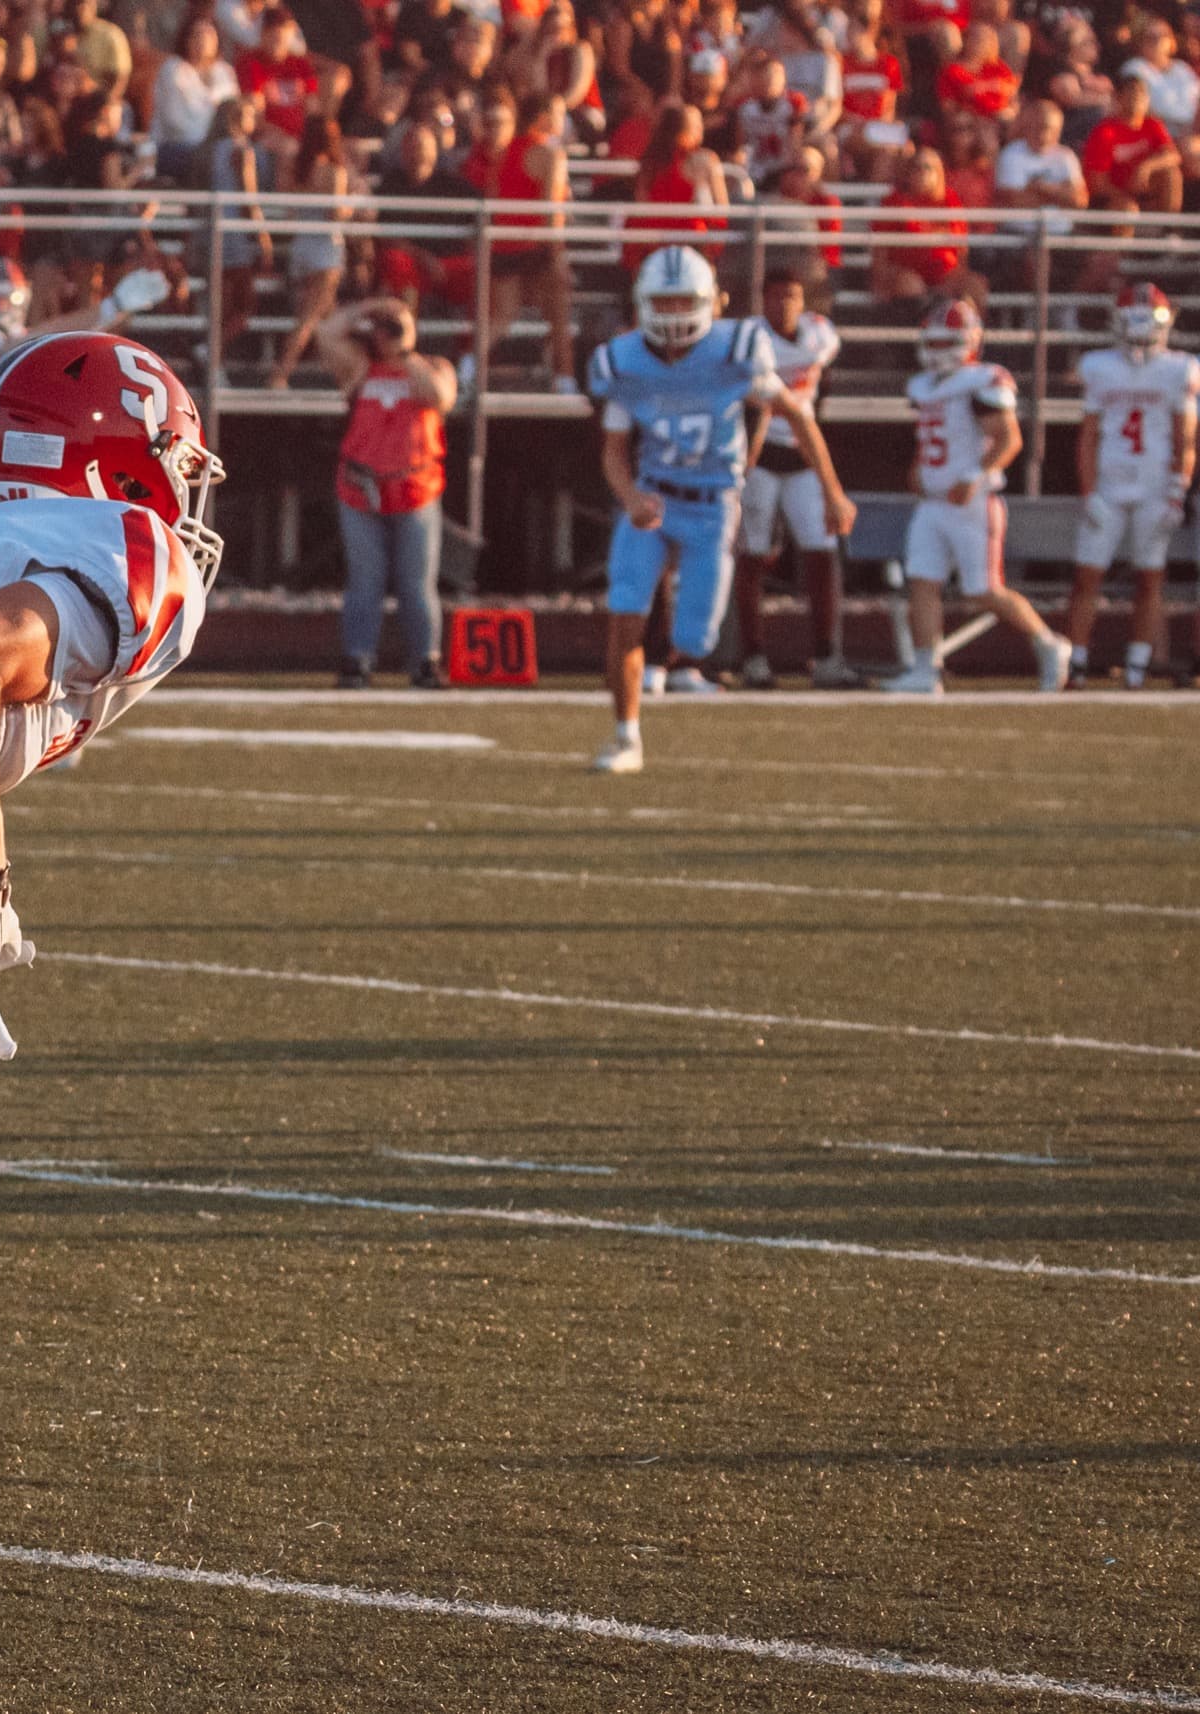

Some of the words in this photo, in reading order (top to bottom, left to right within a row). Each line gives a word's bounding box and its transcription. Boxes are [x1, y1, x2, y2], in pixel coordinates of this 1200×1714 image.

[113, 344, 168, 425] S
[1121, 408, 1145, 454] 4
[466, 618, 525, 675] 50
